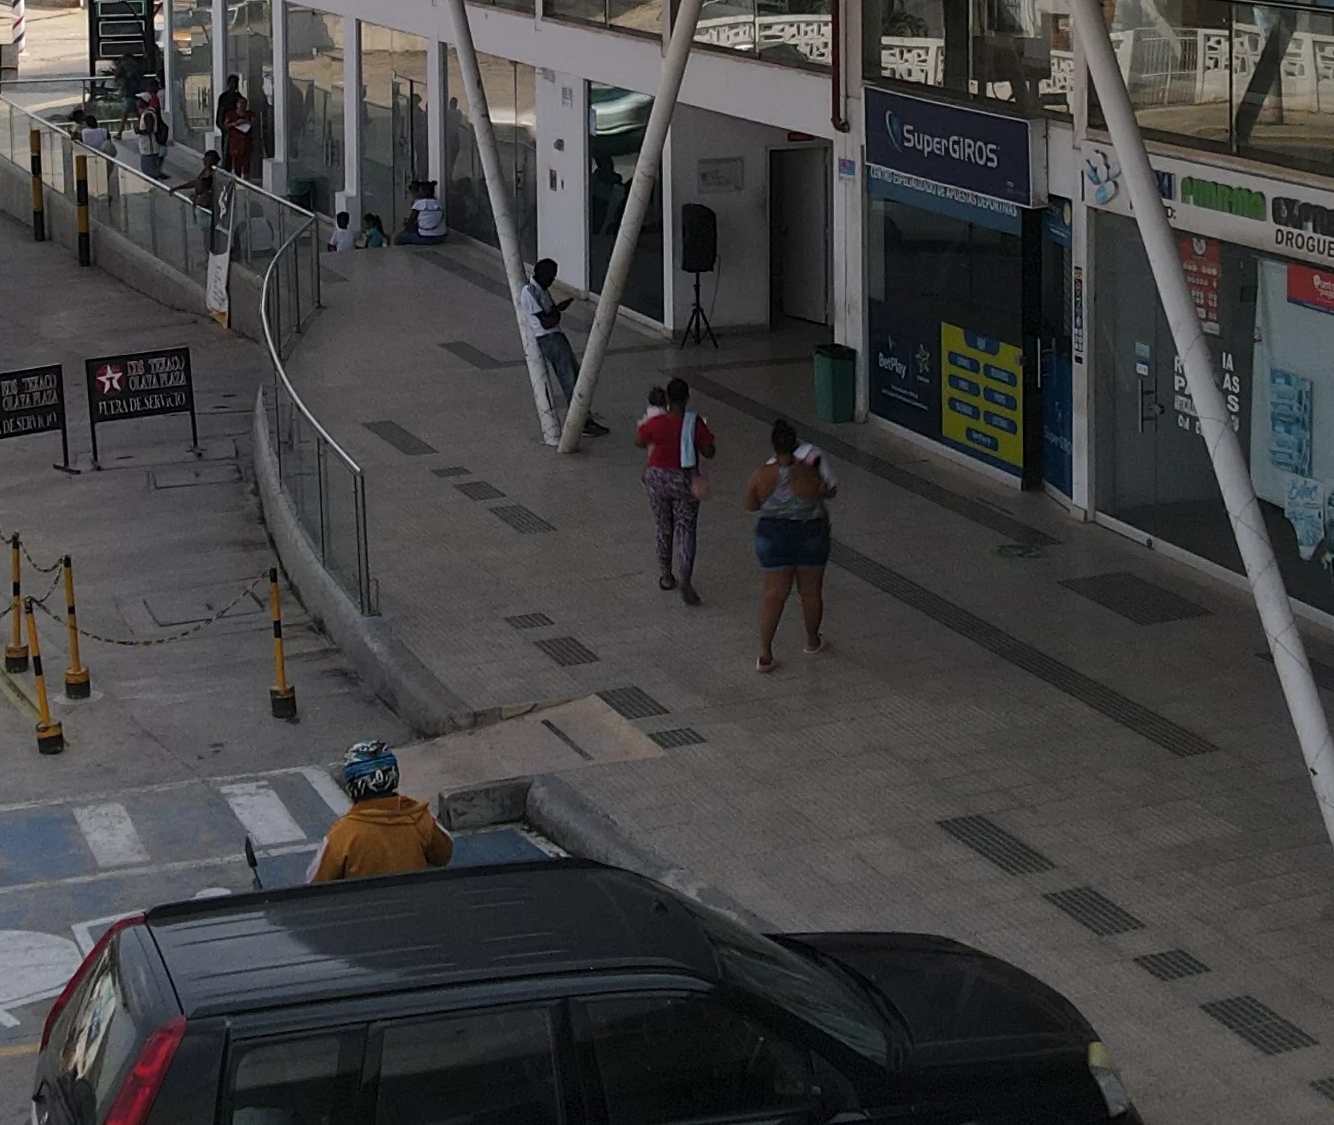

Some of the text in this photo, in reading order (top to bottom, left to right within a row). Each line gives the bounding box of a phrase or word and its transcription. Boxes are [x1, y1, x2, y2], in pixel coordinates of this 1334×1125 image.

[903, 124, 999, 168] SuperGIROS
[946, 187, 977, 206] APUESTAS
[977, 194, 1017, 217] DEPORTIVAS
[148, 355, 185, 374] TEXACO
[878, 351, 907, 379] BetPlay
[22, 374, 58, 393] TEXACO
[159, 369, 187, 388] PLAZA
[33, 390, 59, 408] PLAZA
[99, 398, 128, 415] FUERA
[130, 396, 142, 410] DE
[3, 419, 14, 433] DE
